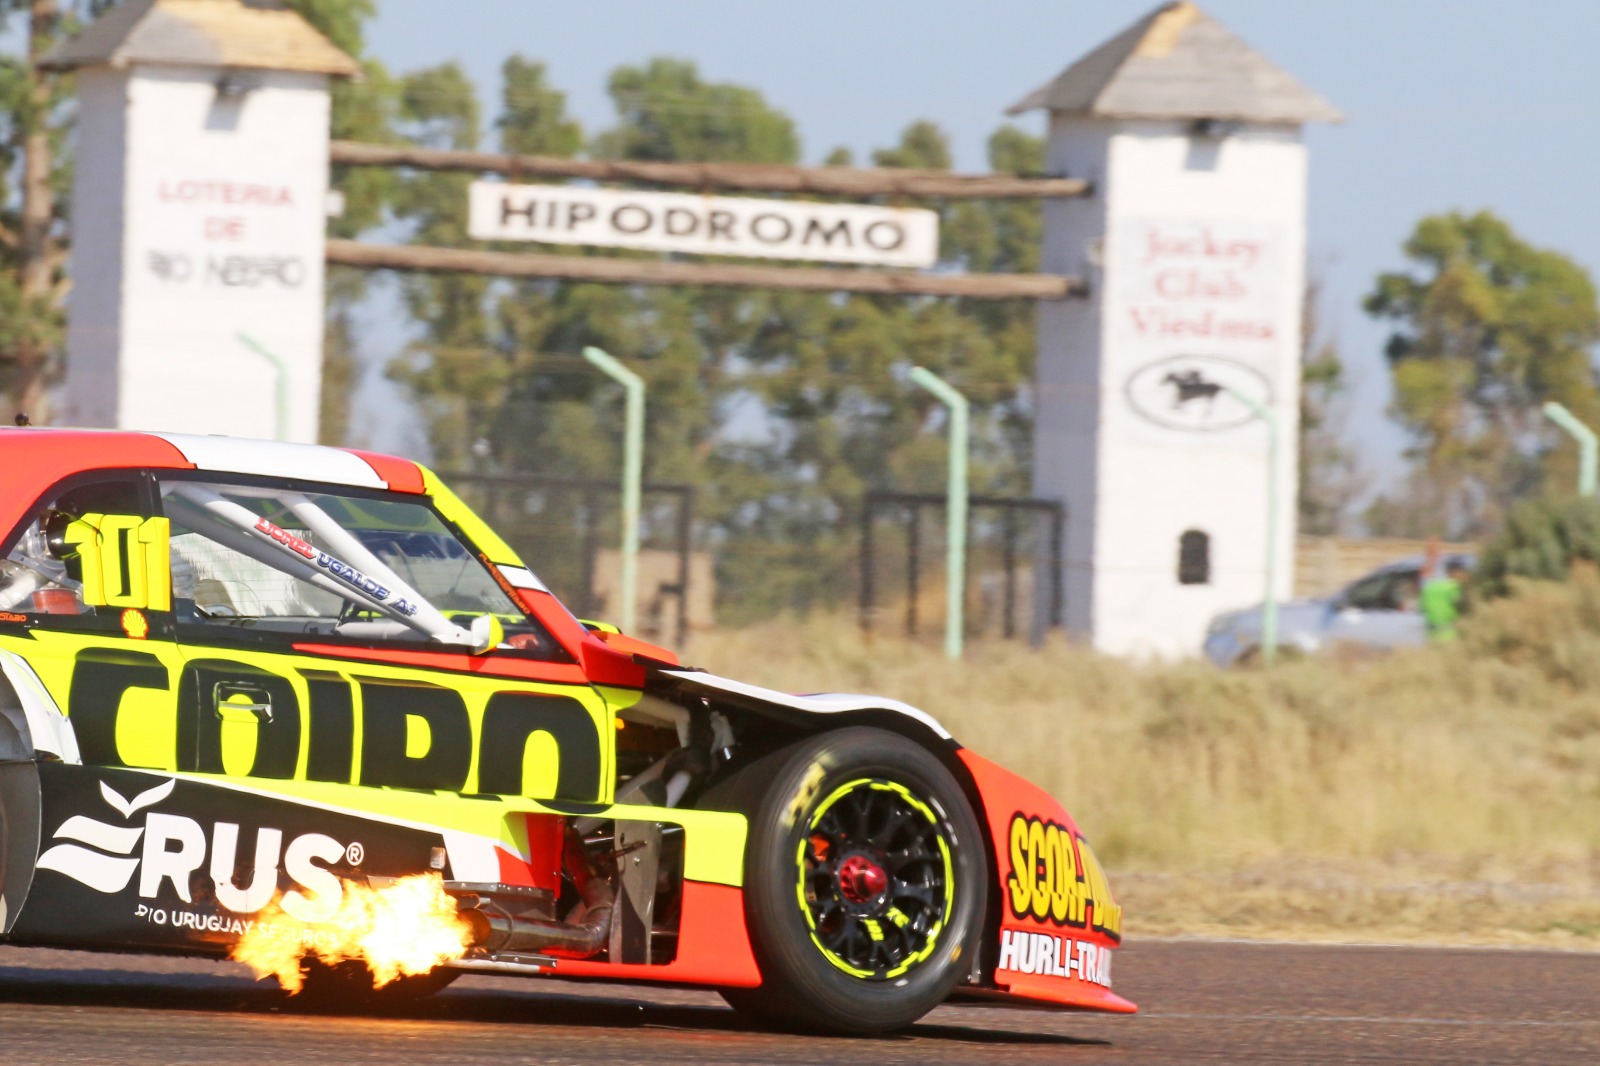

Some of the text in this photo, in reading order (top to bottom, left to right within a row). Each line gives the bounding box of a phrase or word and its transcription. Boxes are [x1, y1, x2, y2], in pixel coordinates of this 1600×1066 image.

[157, 178, 294, 206] LOTERIA
[204, 216, 246, 241] DE
[498, 197, 908, 252] HIPODROMO
[1141, 226, 1264, 268] Jockey
[1154, 268, 1248, 302] Club
[1129, 306, 1276, 341] Viedma
[64, 513, 171, 612] 101
[254, 517, 316, 559] LIONEL
[317, 552, 390, 600] UGALDE
[171, 911, 254, 936] URUGUAY
